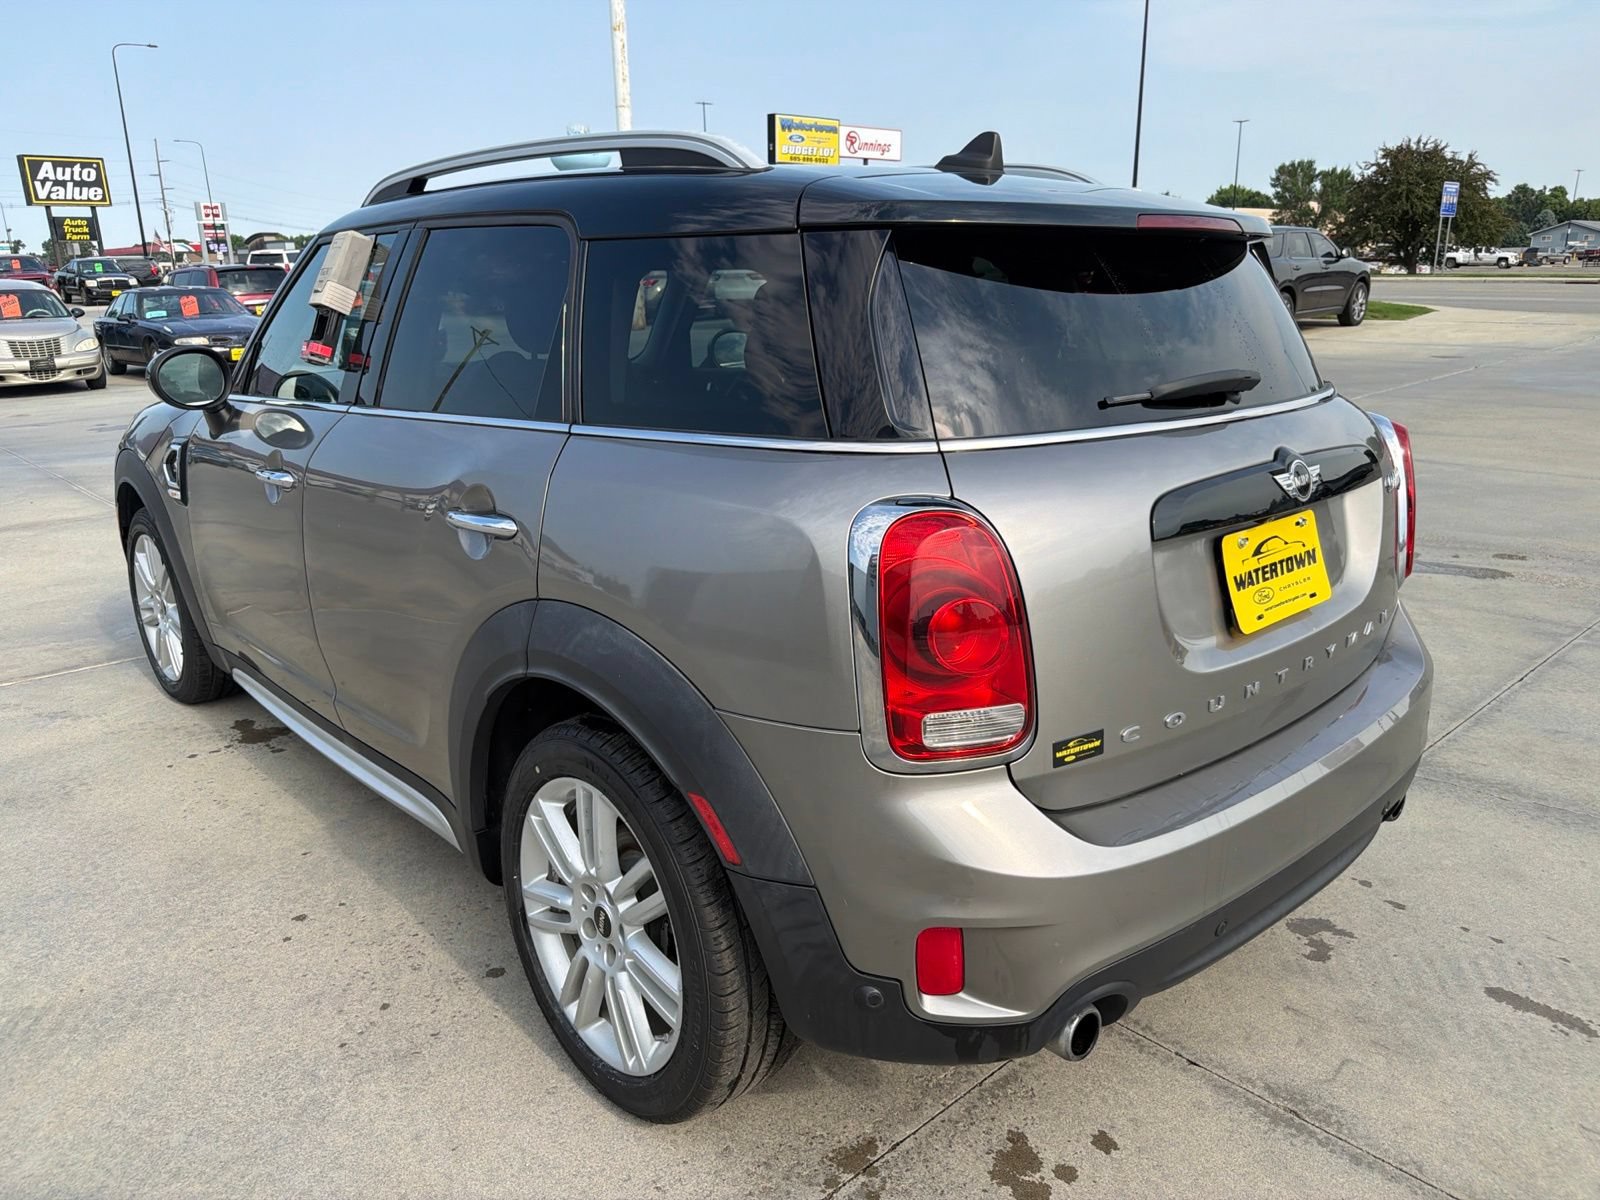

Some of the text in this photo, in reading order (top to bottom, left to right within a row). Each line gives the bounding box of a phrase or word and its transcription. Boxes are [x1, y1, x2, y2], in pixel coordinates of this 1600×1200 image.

[781, 145, 817, 157] BUDGET
[819, 147, 836, 158] LOT
[36, 161, 97, 182] Auto
[33, 181, 103, 201] Value
[64, 218, 88, 226] Auto
[1233, 546, 1318, 592] WATERTOWN
[1278, 576, 1312, 592] CHRYSLER
